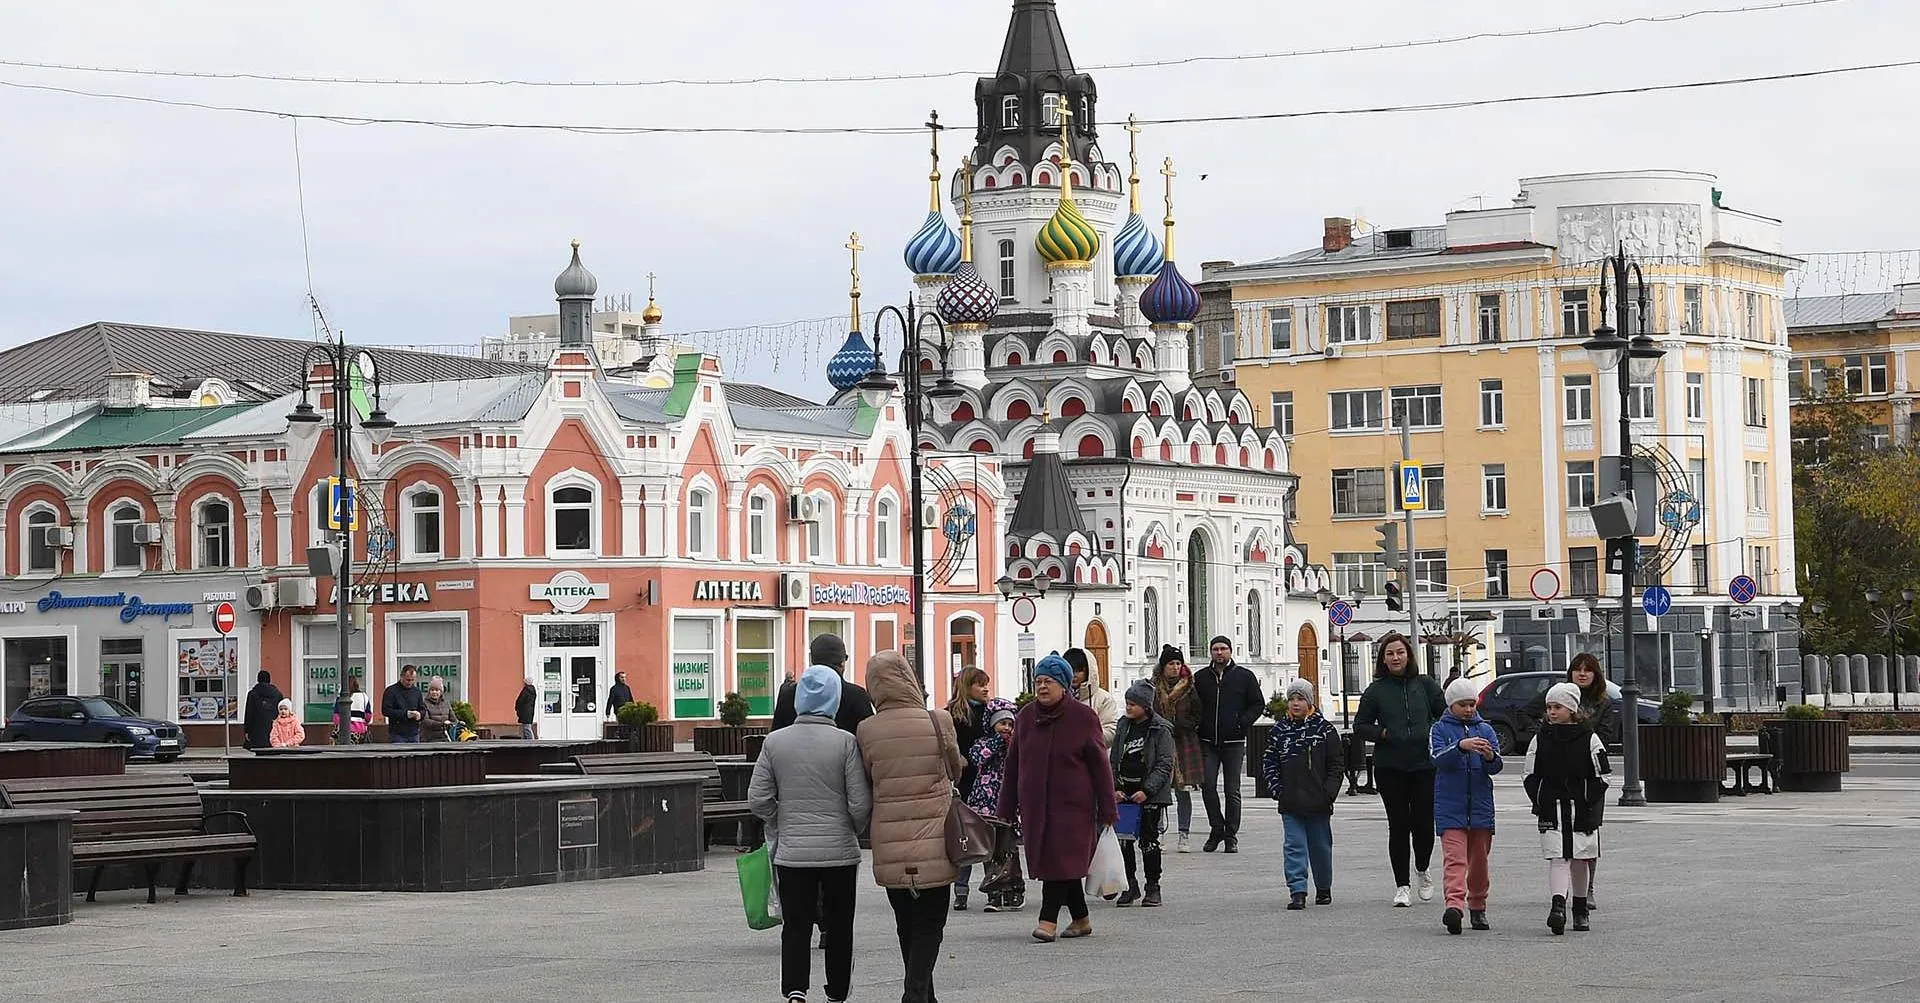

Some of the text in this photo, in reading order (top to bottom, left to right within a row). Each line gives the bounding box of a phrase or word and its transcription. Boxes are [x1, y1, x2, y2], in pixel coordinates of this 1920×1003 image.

[544, 586, 595, 596] АПТЕКА
[694, 580, 763, 600] АПТЕКА
[813, 584, 853, 602] Баскин
[869, 586, 910, 603] Роббинс
[311, 667, 362, 678] НИЗИЕ
[416, 665, 457, 676] ИЗКИЕ
[674, 663, 708, 673] НИЗКИЕ
[678, 679, 704, 691] ЦЕНЫ
